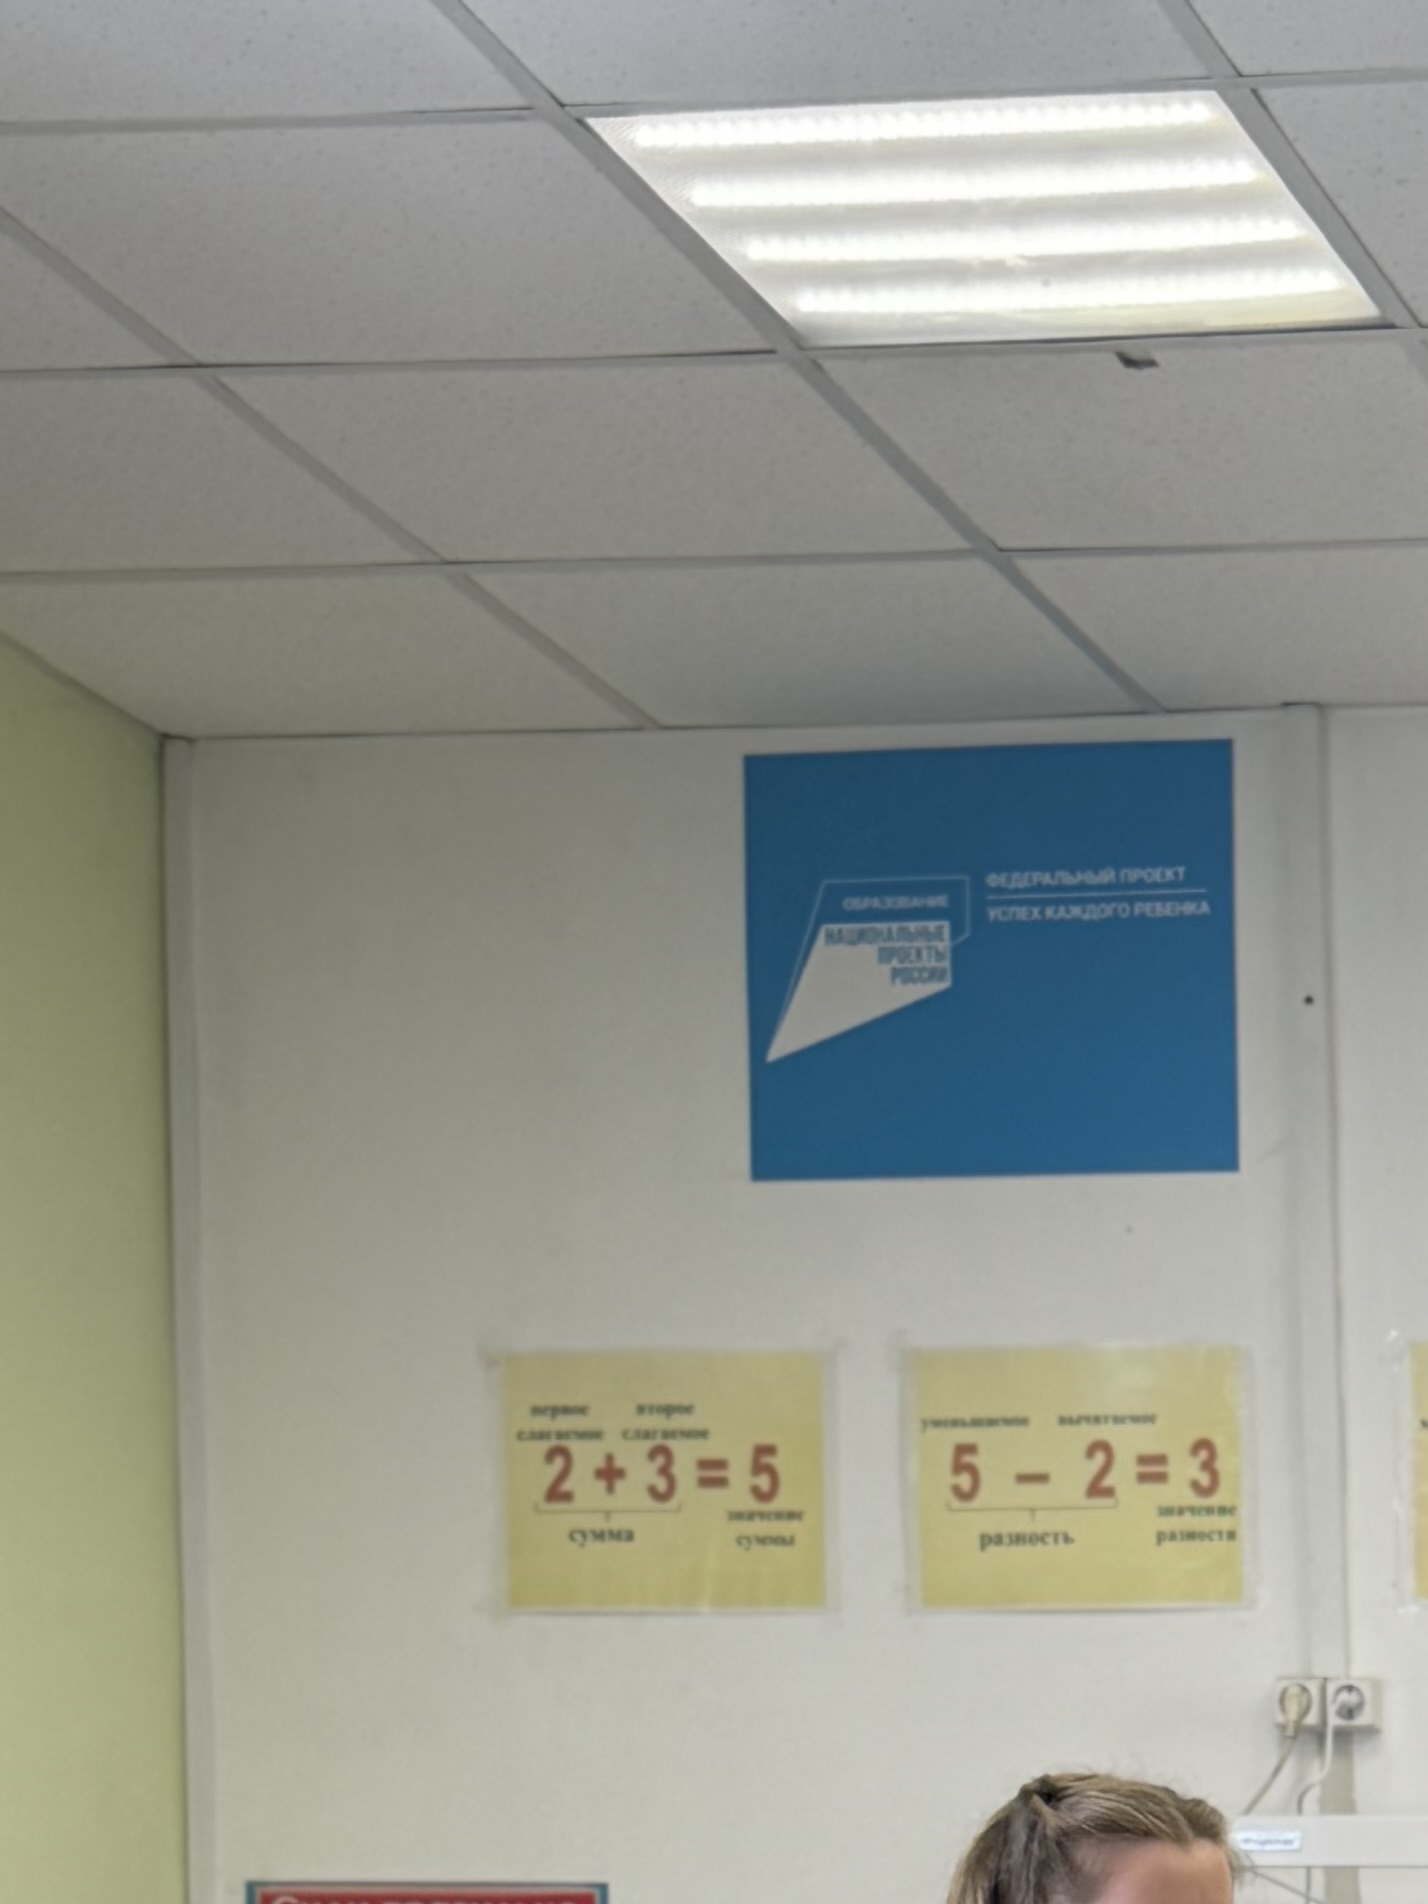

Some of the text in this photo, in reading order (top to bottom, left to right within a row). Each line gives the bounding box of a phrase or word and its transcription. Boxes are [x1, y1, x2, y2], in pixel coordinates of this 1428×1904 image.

[985, 866, 1186, 889] ФЕДЕРАЛЬНЫЙ ПРОЕКТ
[842, 894, 948, 912] ОБРАЗОВАНИЕ
[987, 904, 1041, 922] УСПЕХ
[1045, 902, 1130, 921] КАЖДОГО
[824, 925, 946, 947] НАЦИОНАЛЬНЫЕ
[877, 946, 947, 966] ПРОЕКТЫ
[890, 966, 947, 986] РОССИИ
[530, 1403, 695, 1420] первое второе
[1057, 1413, 1157, 1426] вычитаемое
[920, 1416, 1029, 1432] уменьшаемое
[516, 1428, 710, 1442] слагаемое слагаемое
[727, 1510, 805, 1522] значение
[1157, 1504, 1237, 1517] значение
[568, 1528, 635, 1547] сумма
[735, 1534, 796, 1551] суммы
[979, 1530, 1075, 1551] разность
[1156, 1529, 1237, 1546] разности
